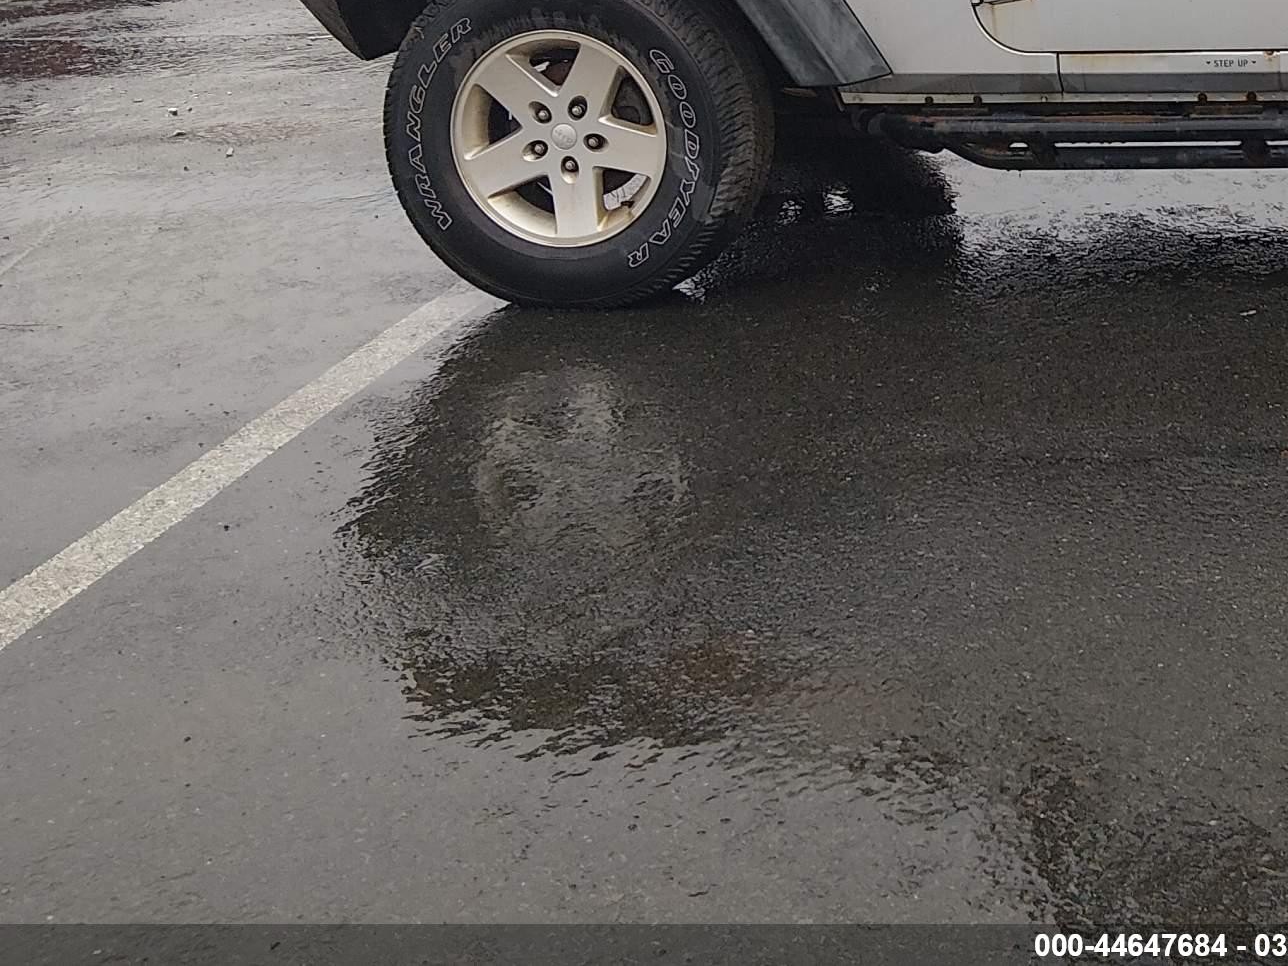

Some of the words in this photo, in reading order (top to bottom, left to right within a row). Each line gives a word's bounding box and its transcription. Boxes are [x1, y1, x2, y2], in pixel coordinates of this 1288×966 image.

[404, 16, 473, 231] WRANGLER
[627, 48, 701, 269] GOODYEAR
[1213, 59, 1234, 68] STEP
[1237, 58, 1249, 67] UP
